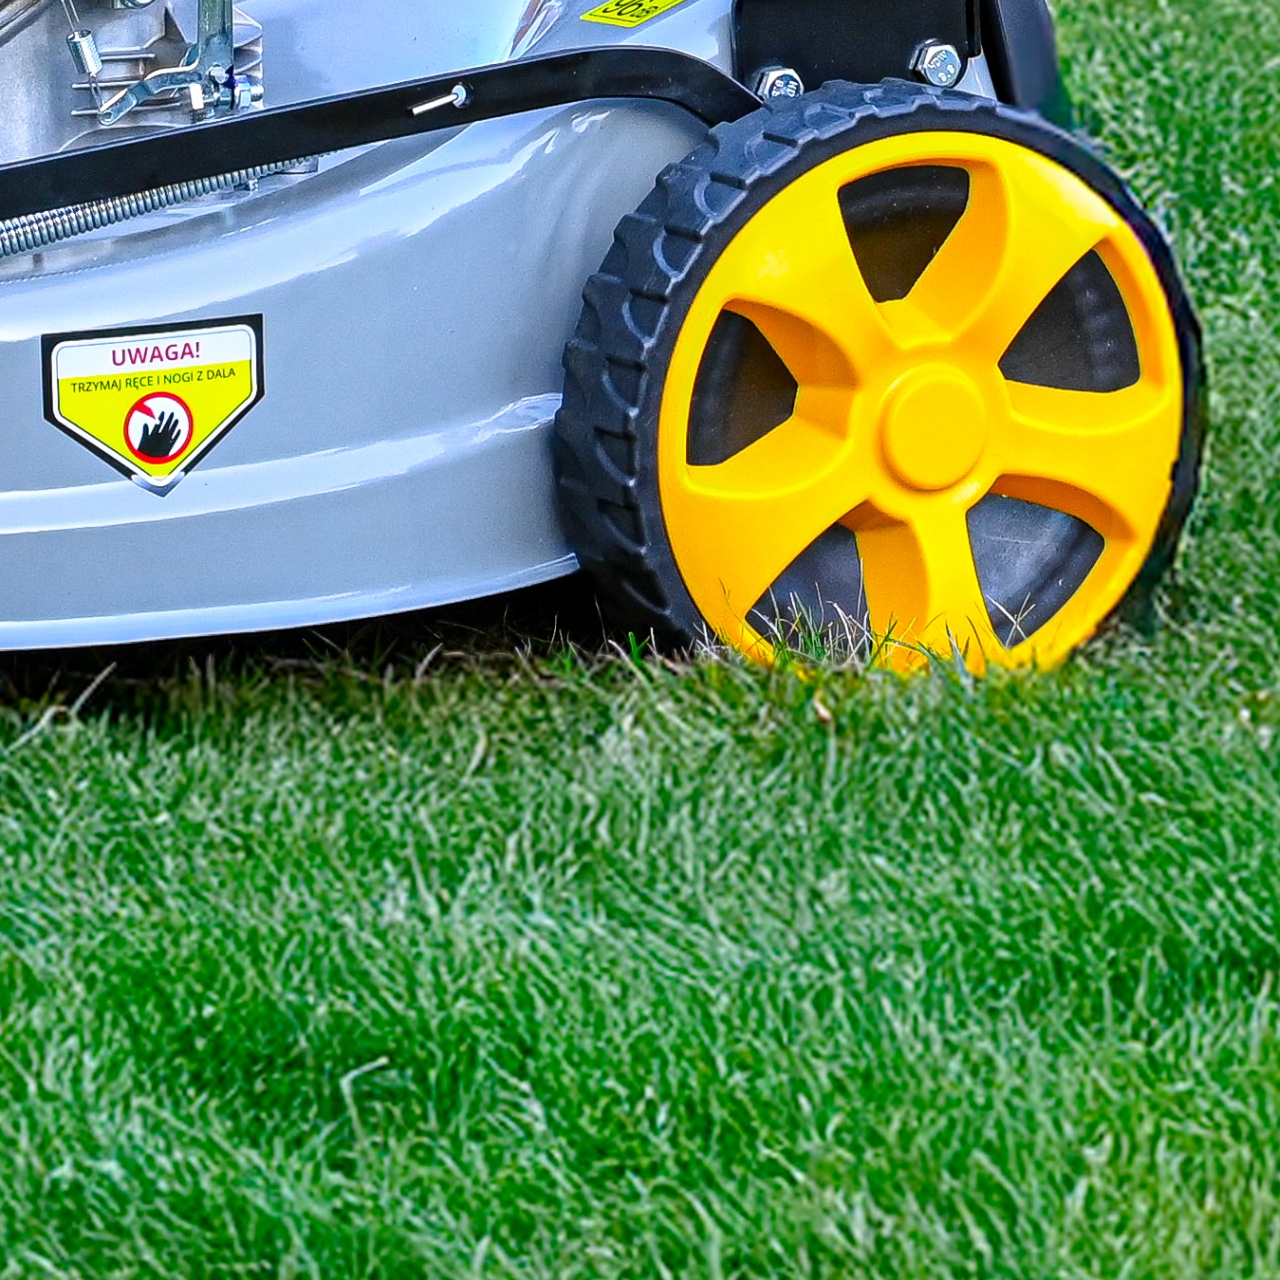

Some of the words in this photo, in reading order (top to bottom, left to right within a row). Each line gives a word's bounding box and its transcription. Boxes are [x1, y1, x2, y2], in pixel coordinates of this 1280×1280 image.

[111, 341, 201, 367] UWAGA!
[70, 378, 122, 393] TRZYMAJ
[125, 375, 154, 390] RĘCE
[163, 371, 194, 385] NOGI
[196, 370, 203, 381] Z
[206, 367, 236, 380] DALA
